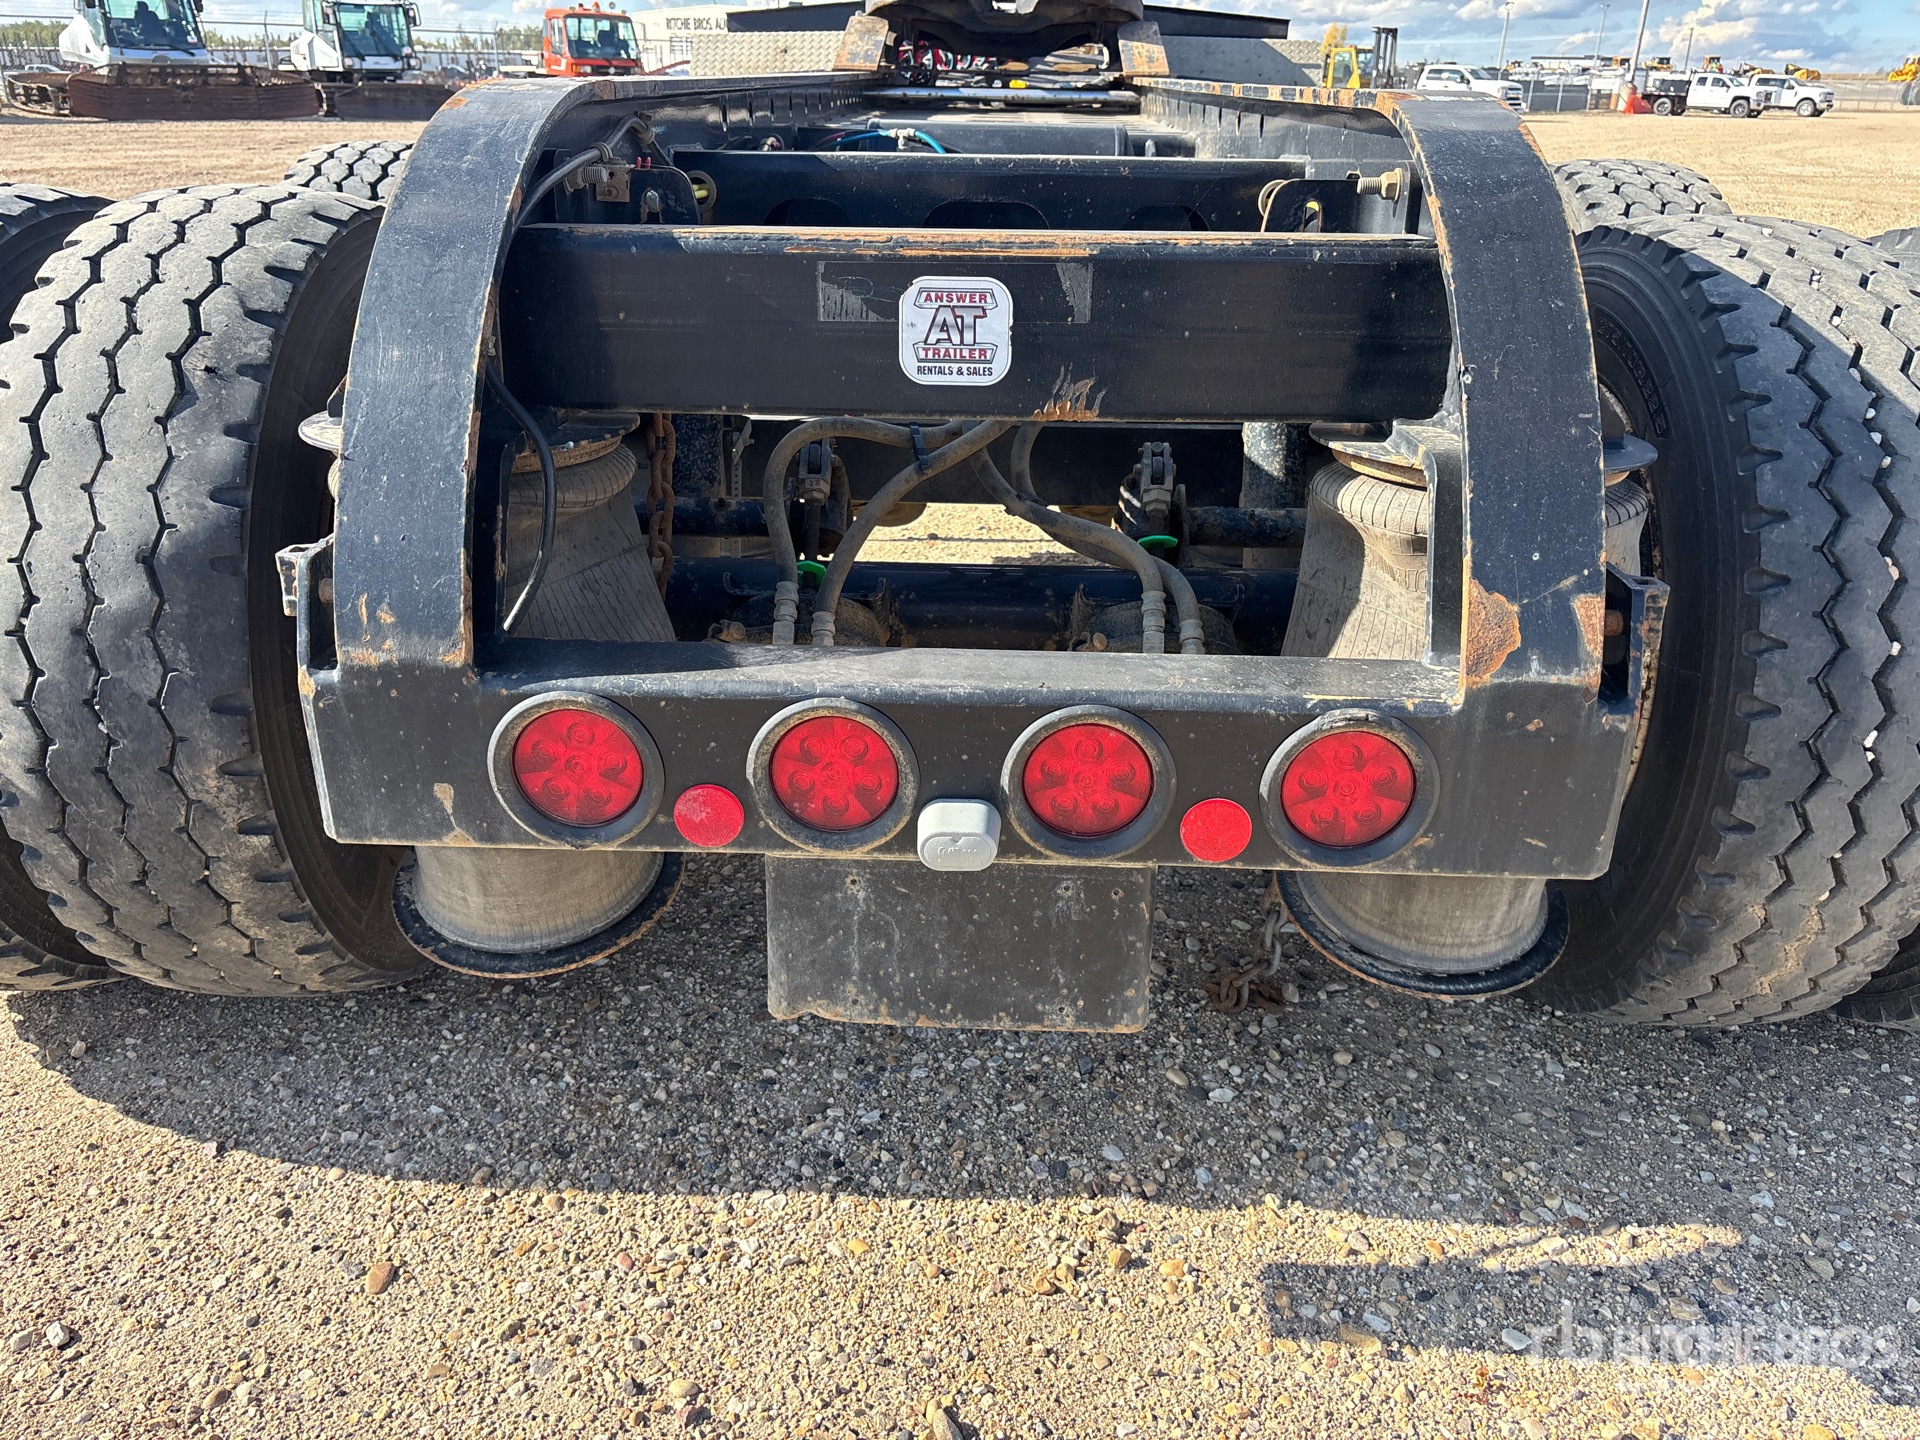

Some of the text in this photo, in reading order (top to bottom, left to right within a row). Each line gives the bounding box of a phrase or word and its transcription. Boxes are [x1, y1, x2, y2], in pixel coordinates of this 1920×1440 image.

[715, 17, 728, 30] AU
[923, 292, 988, 304] ANSWER
[924, 305, 987, 346] AT
[922, 348, 988, 360] TRAILER
[917, 365, 993, 377] RENTALS & SALES
